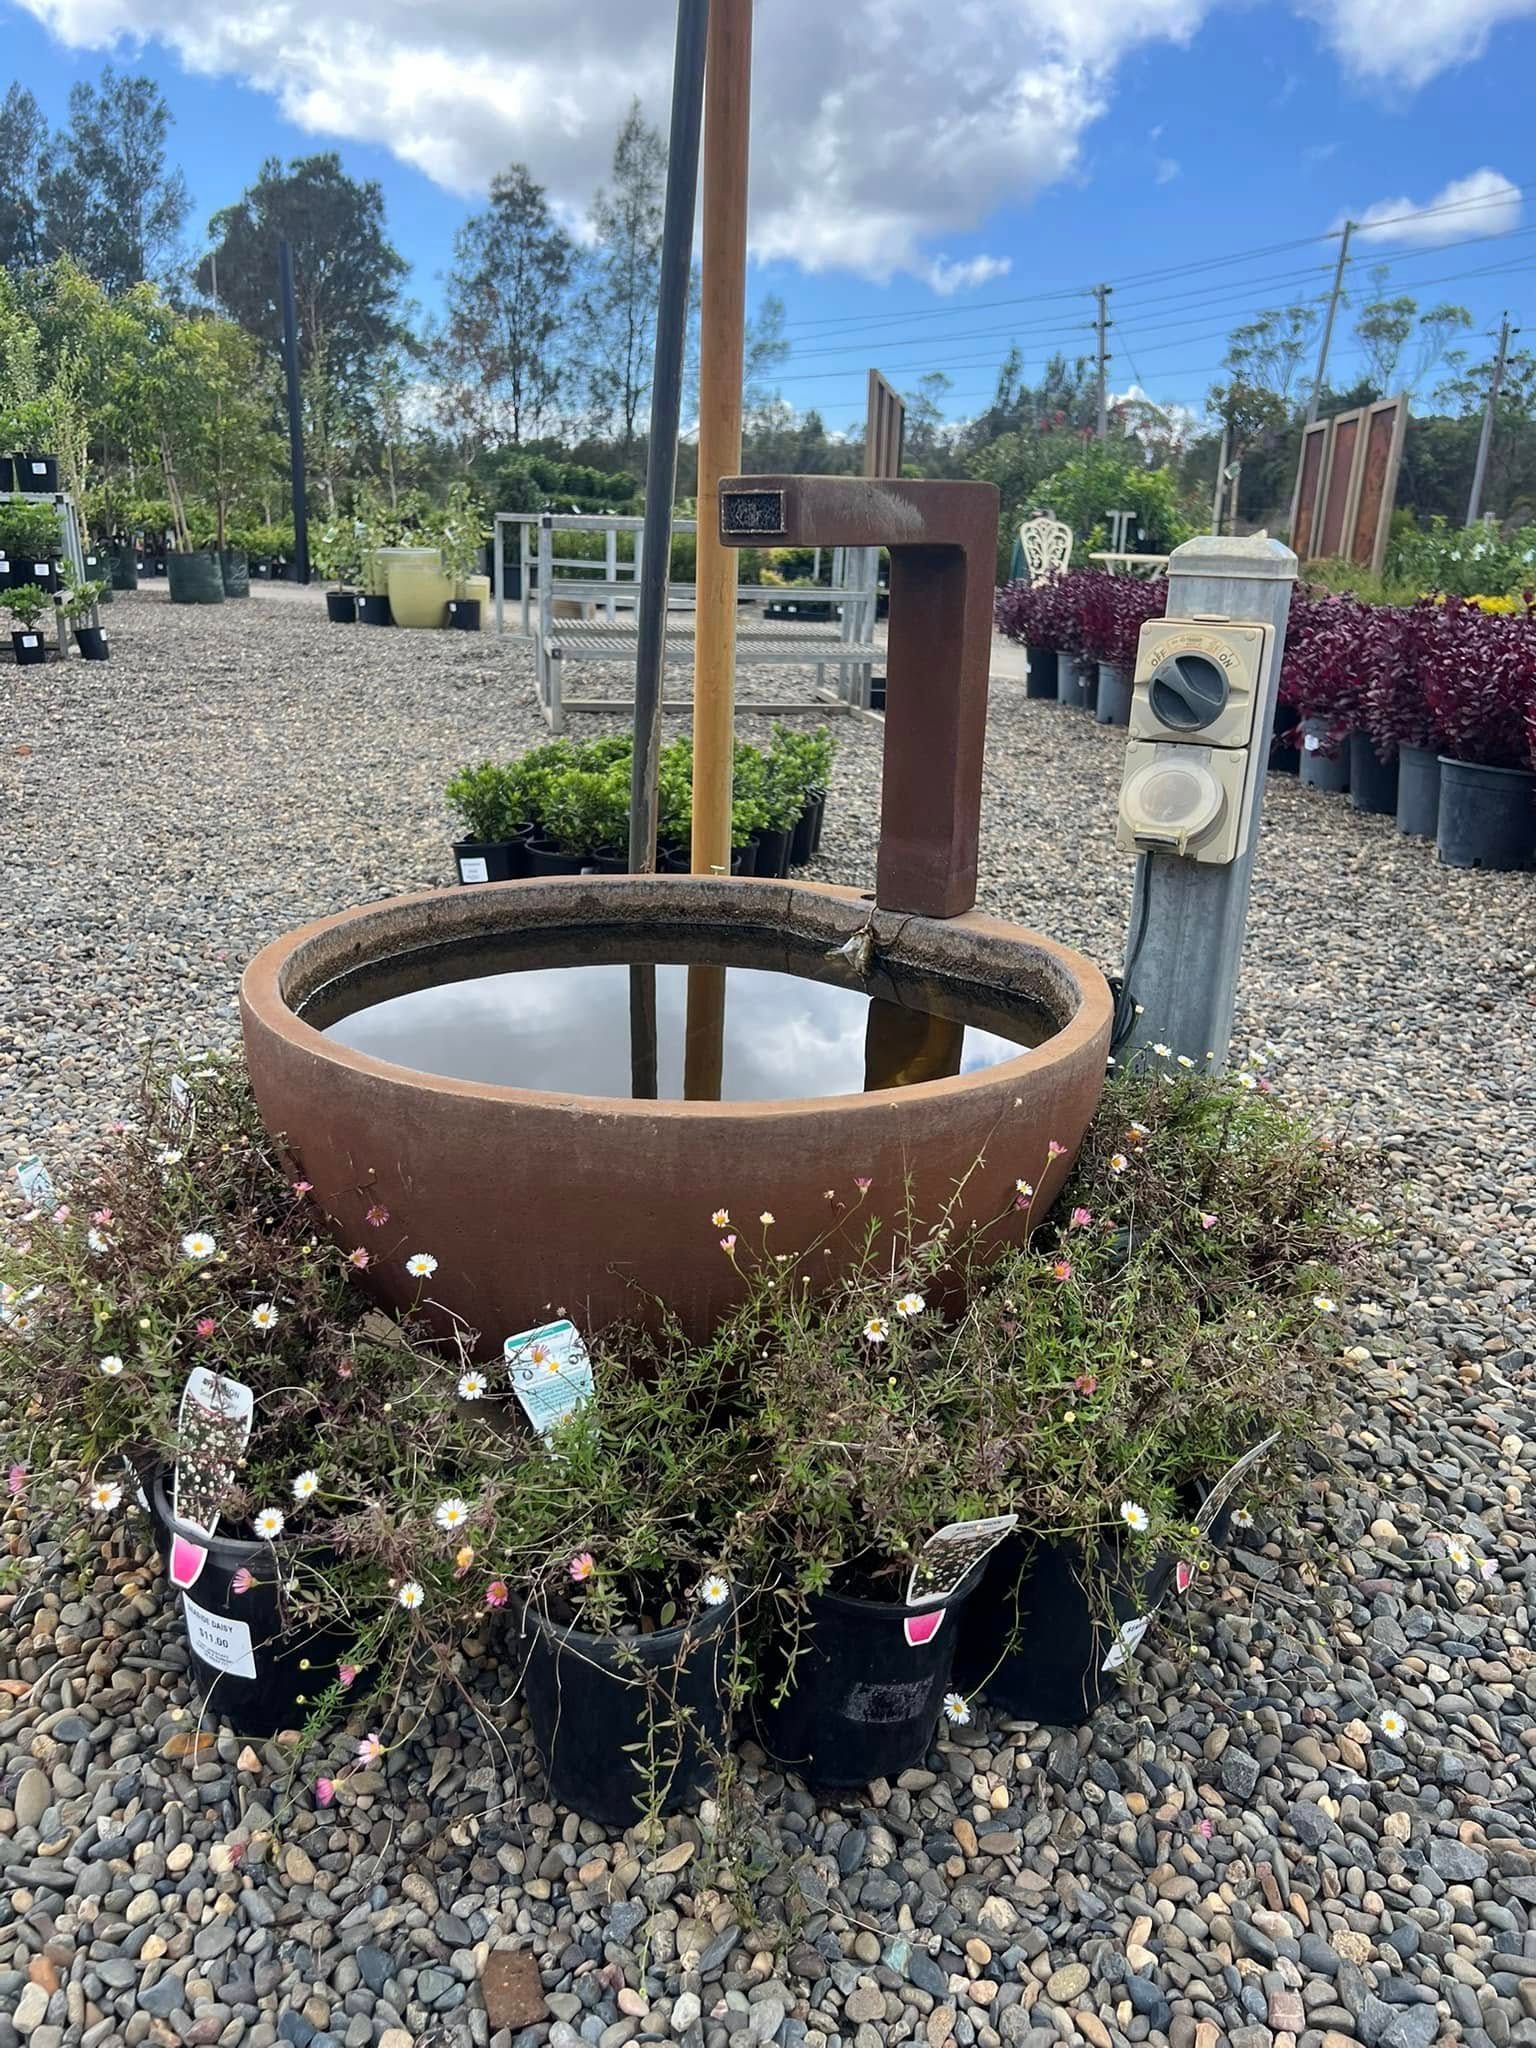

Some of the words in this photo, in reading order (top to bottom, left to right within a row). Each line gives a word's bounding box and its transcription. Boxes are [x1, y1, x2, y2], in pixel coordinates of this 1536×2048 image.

[1151, 648, 1168, 667] OFF
[1219, 653, 1233, 668] ON
[211, 1620, 233, 1633] DAISY
[199, 1627, 229, 1649] $11.00
